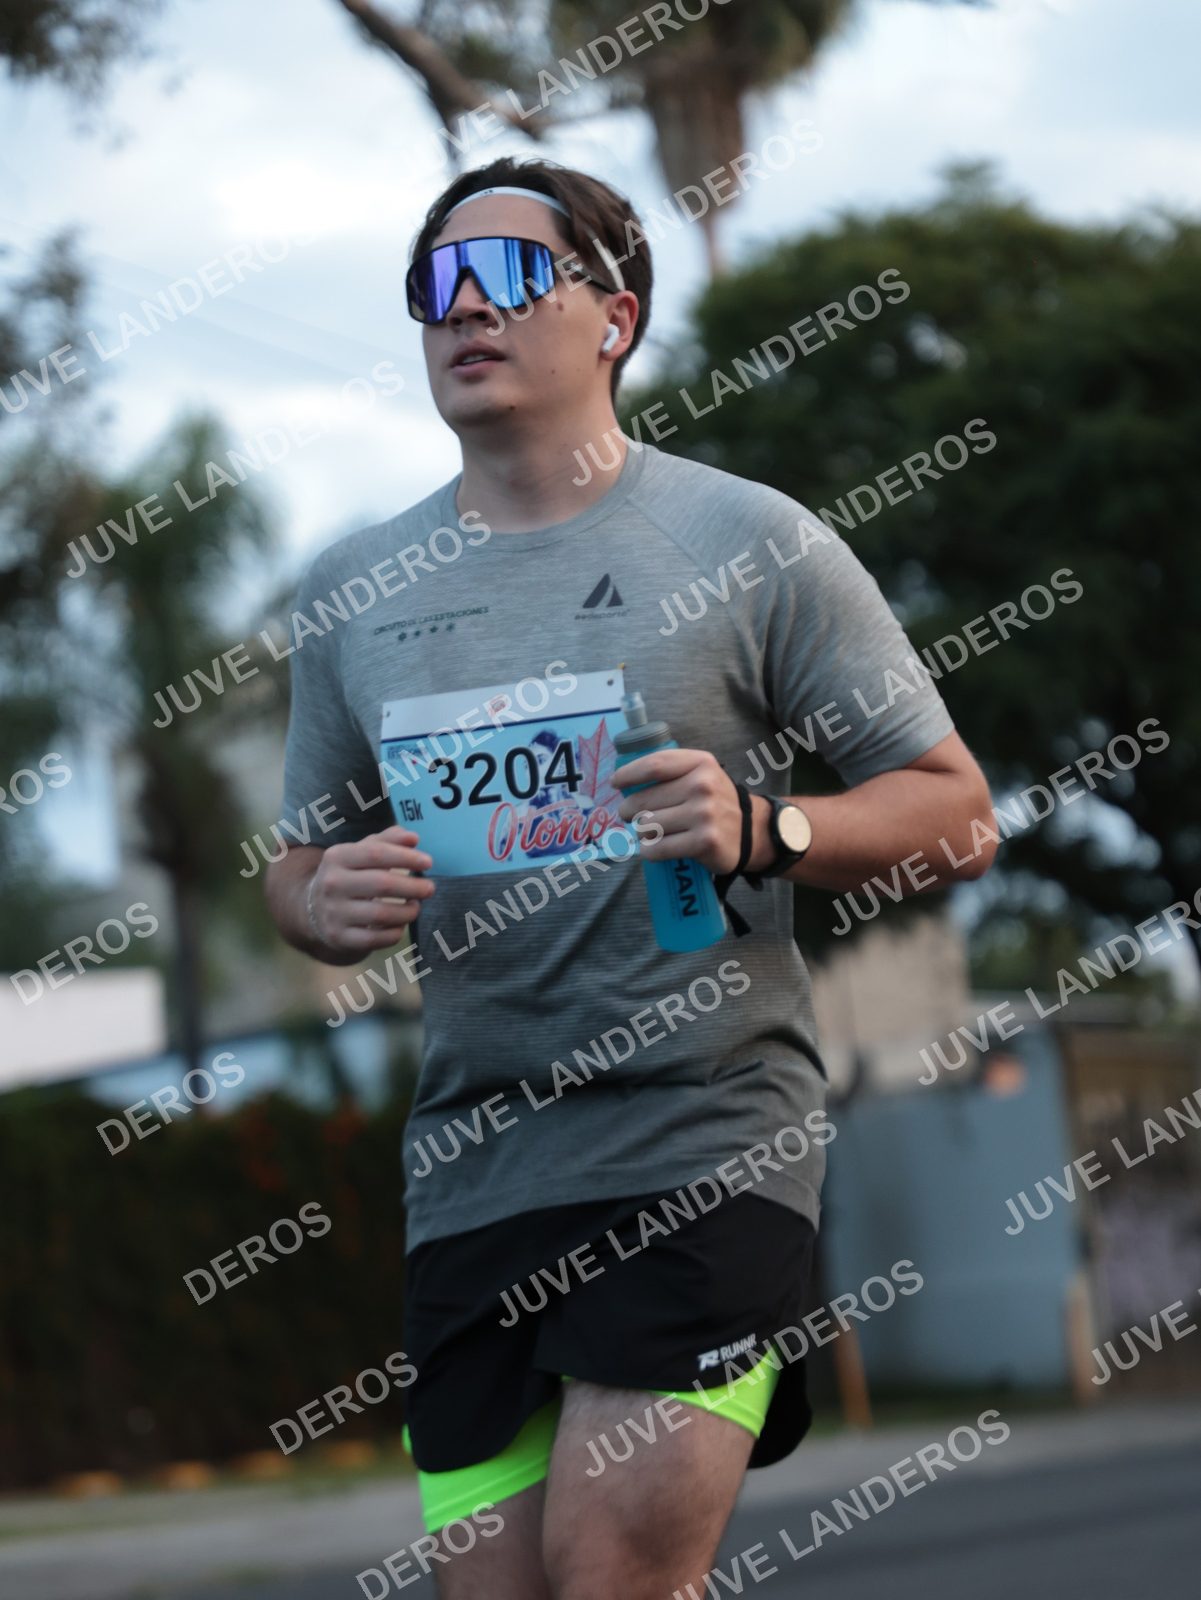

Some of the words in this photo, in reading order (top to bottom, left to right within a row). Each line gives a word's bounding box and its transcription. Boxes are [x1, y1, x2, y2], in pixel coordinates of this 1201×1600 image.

[428, 740, 584, 810] 3204
[400, 799, 424, 822] 15k
[673, 857, 700, 918] HAN
